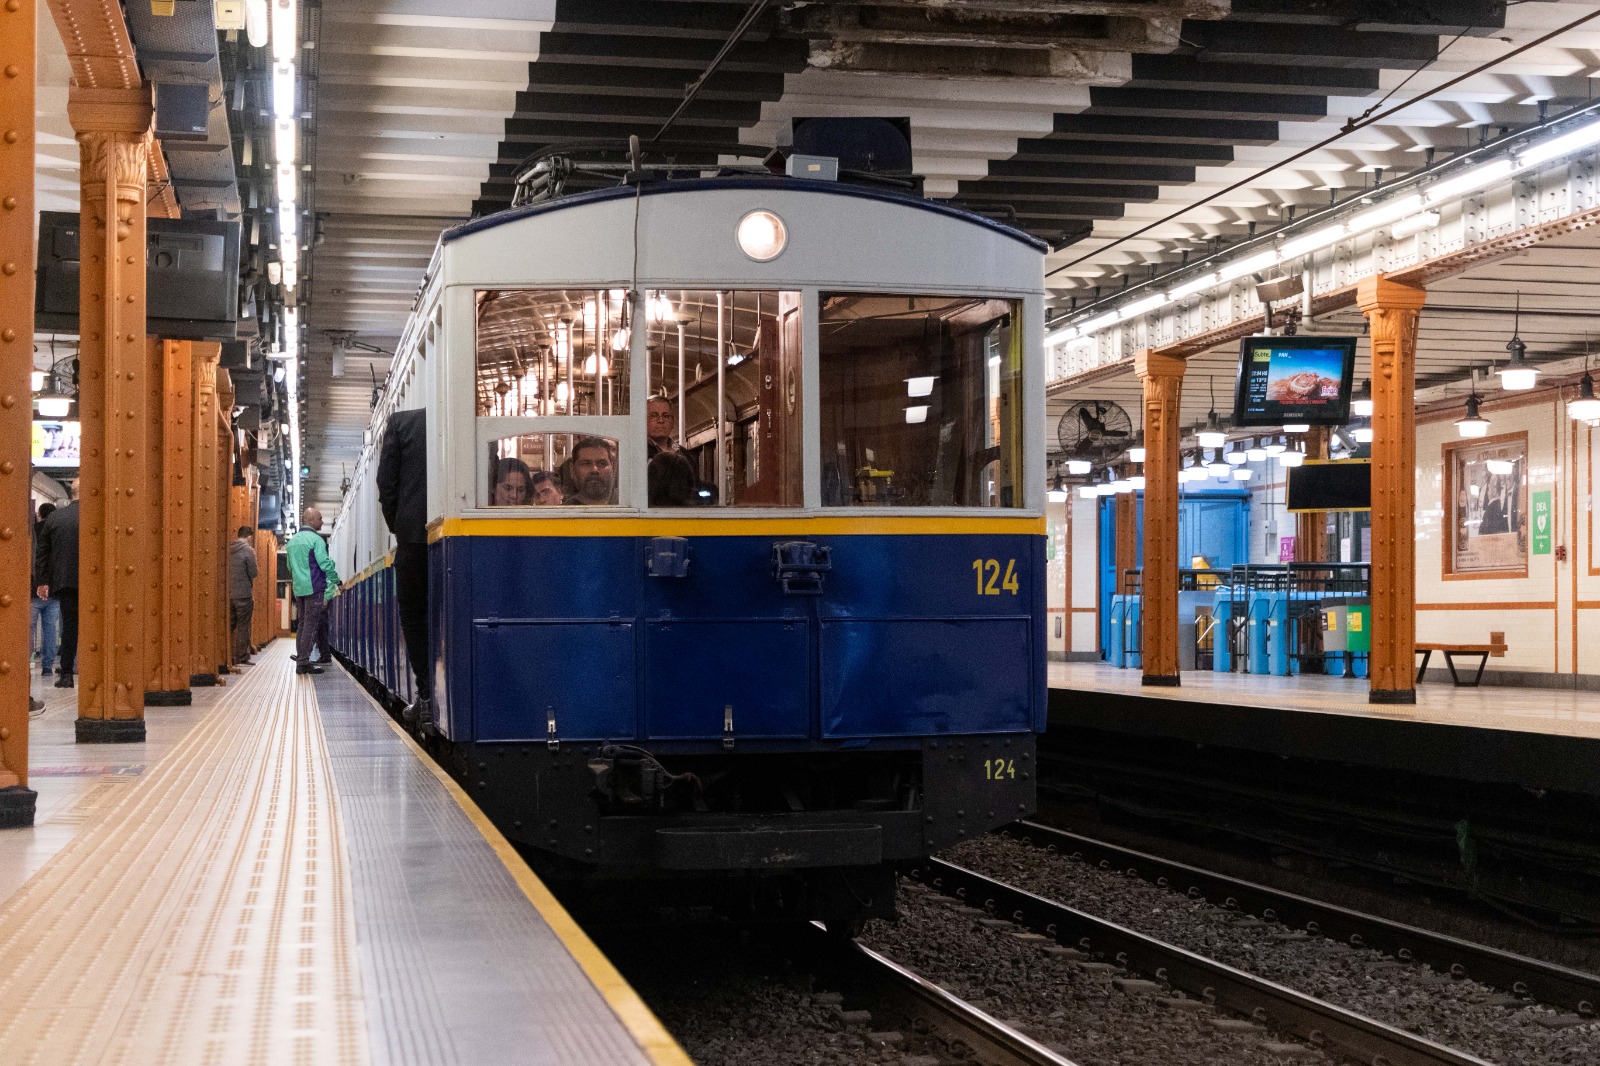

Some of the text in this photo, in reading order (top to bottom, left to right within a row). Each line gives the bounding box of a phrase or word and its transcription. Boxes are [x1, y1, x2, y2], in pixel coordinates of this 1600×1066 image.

[1536, 502, 1547, 511] DEA
[972, 559, 1019, 595] 124
[984, 759, 1015, 780] 124
